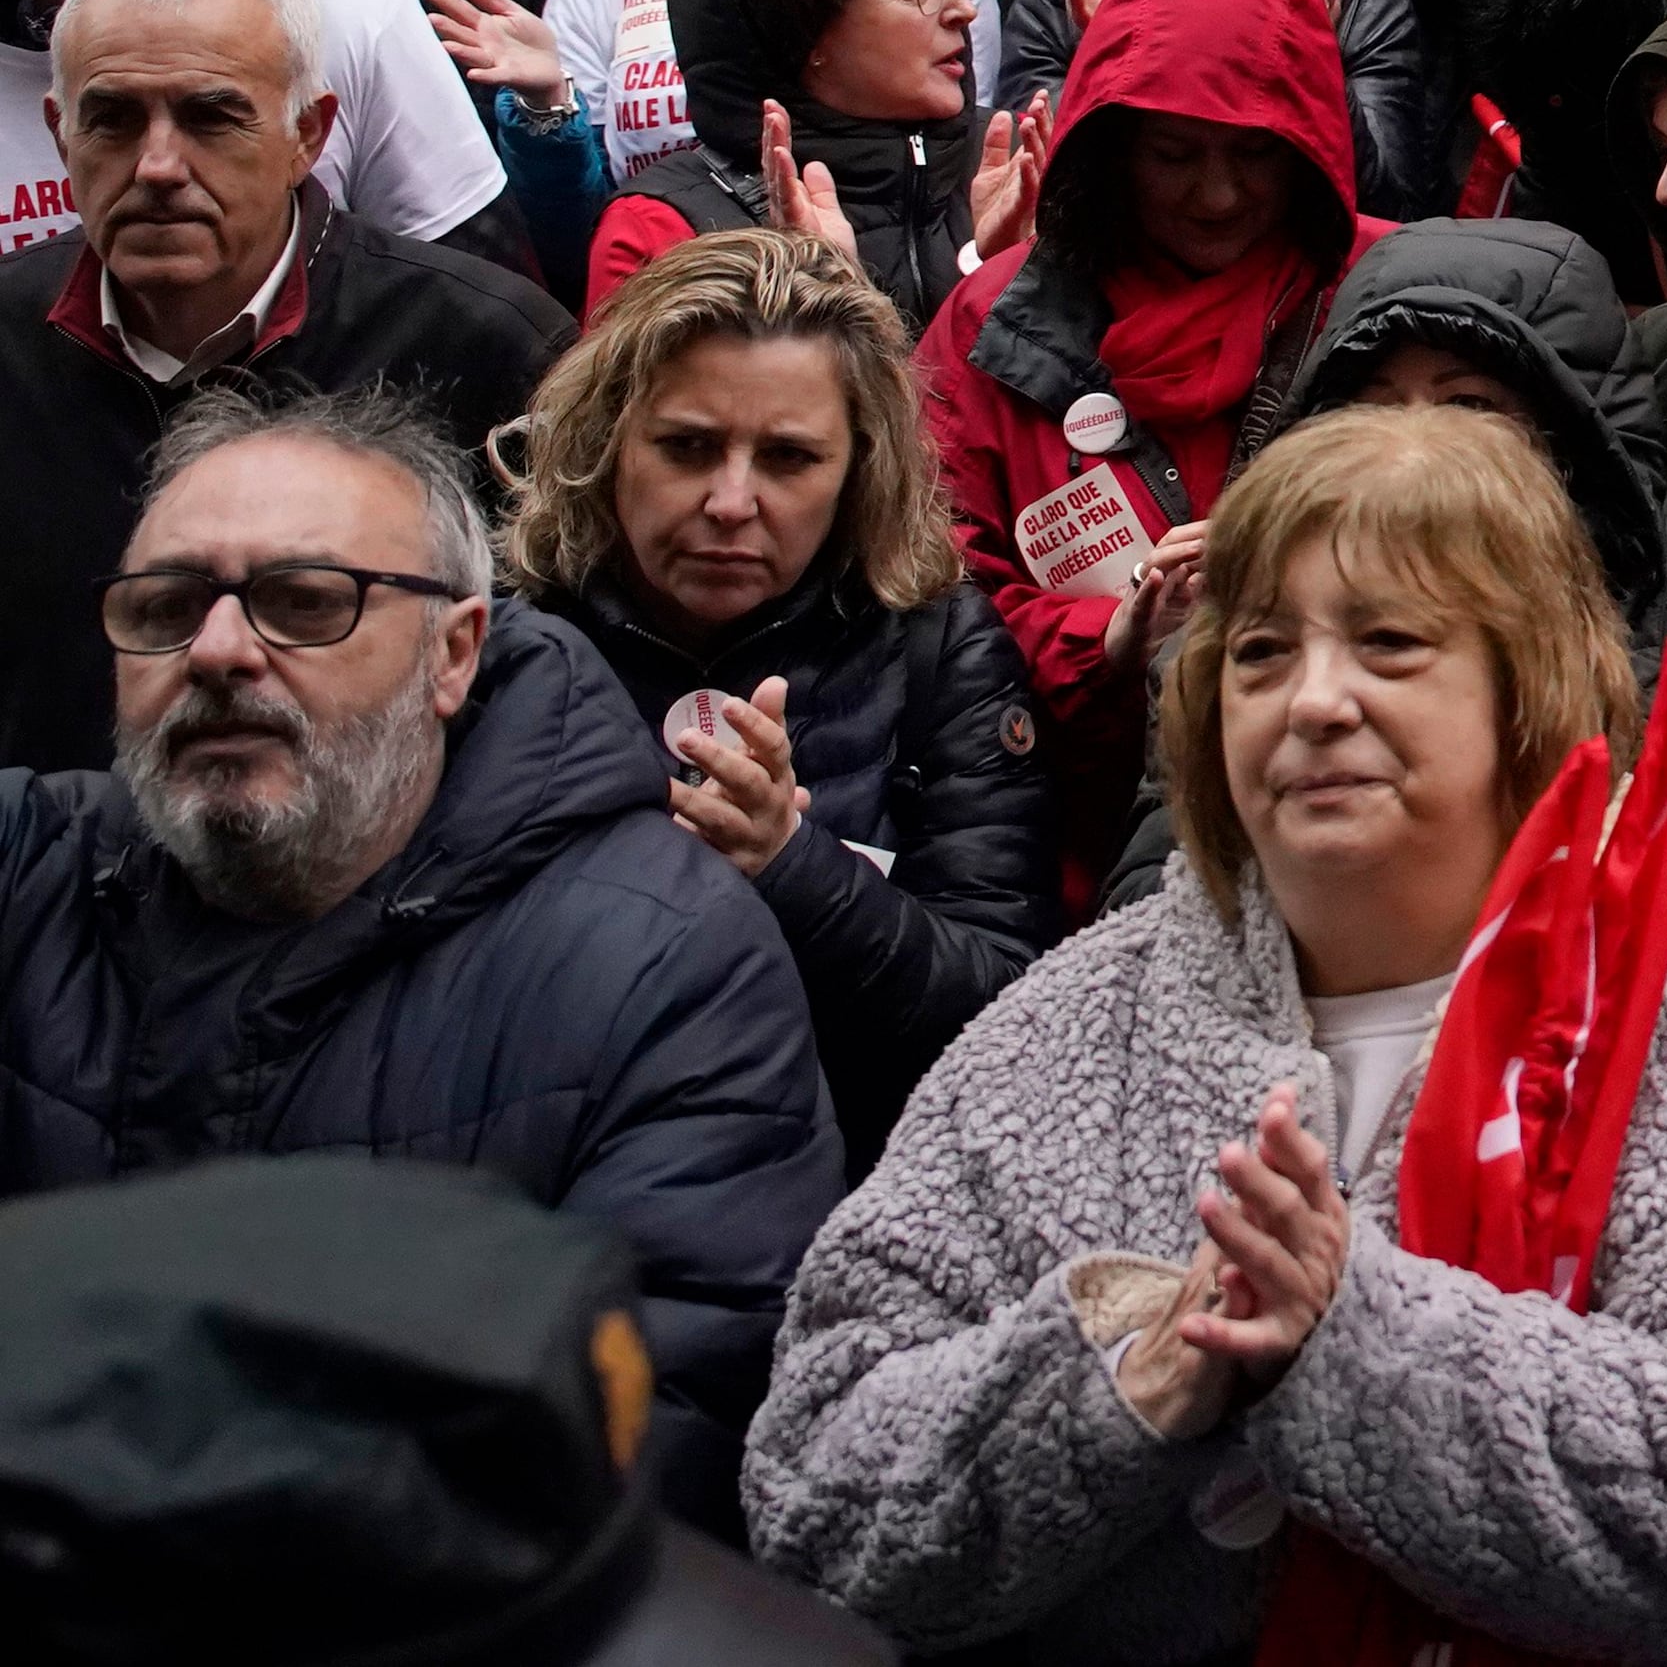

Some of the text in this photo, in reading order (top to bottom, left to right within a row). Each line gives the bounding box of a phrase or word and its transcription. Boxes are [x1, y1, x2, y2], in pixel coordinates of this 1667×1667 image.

[624, 60, 685, 92] CLAR
[1065, 408, 1124, 435] ¡QUÉÉÉDATE!
[1023, 481, 1102, 536] CLARO QUE
[1025, 496, 1124, 562] VALE LA PENA
[1046, 525, 1135, 591] ¡QUÉÉÉDATE!
